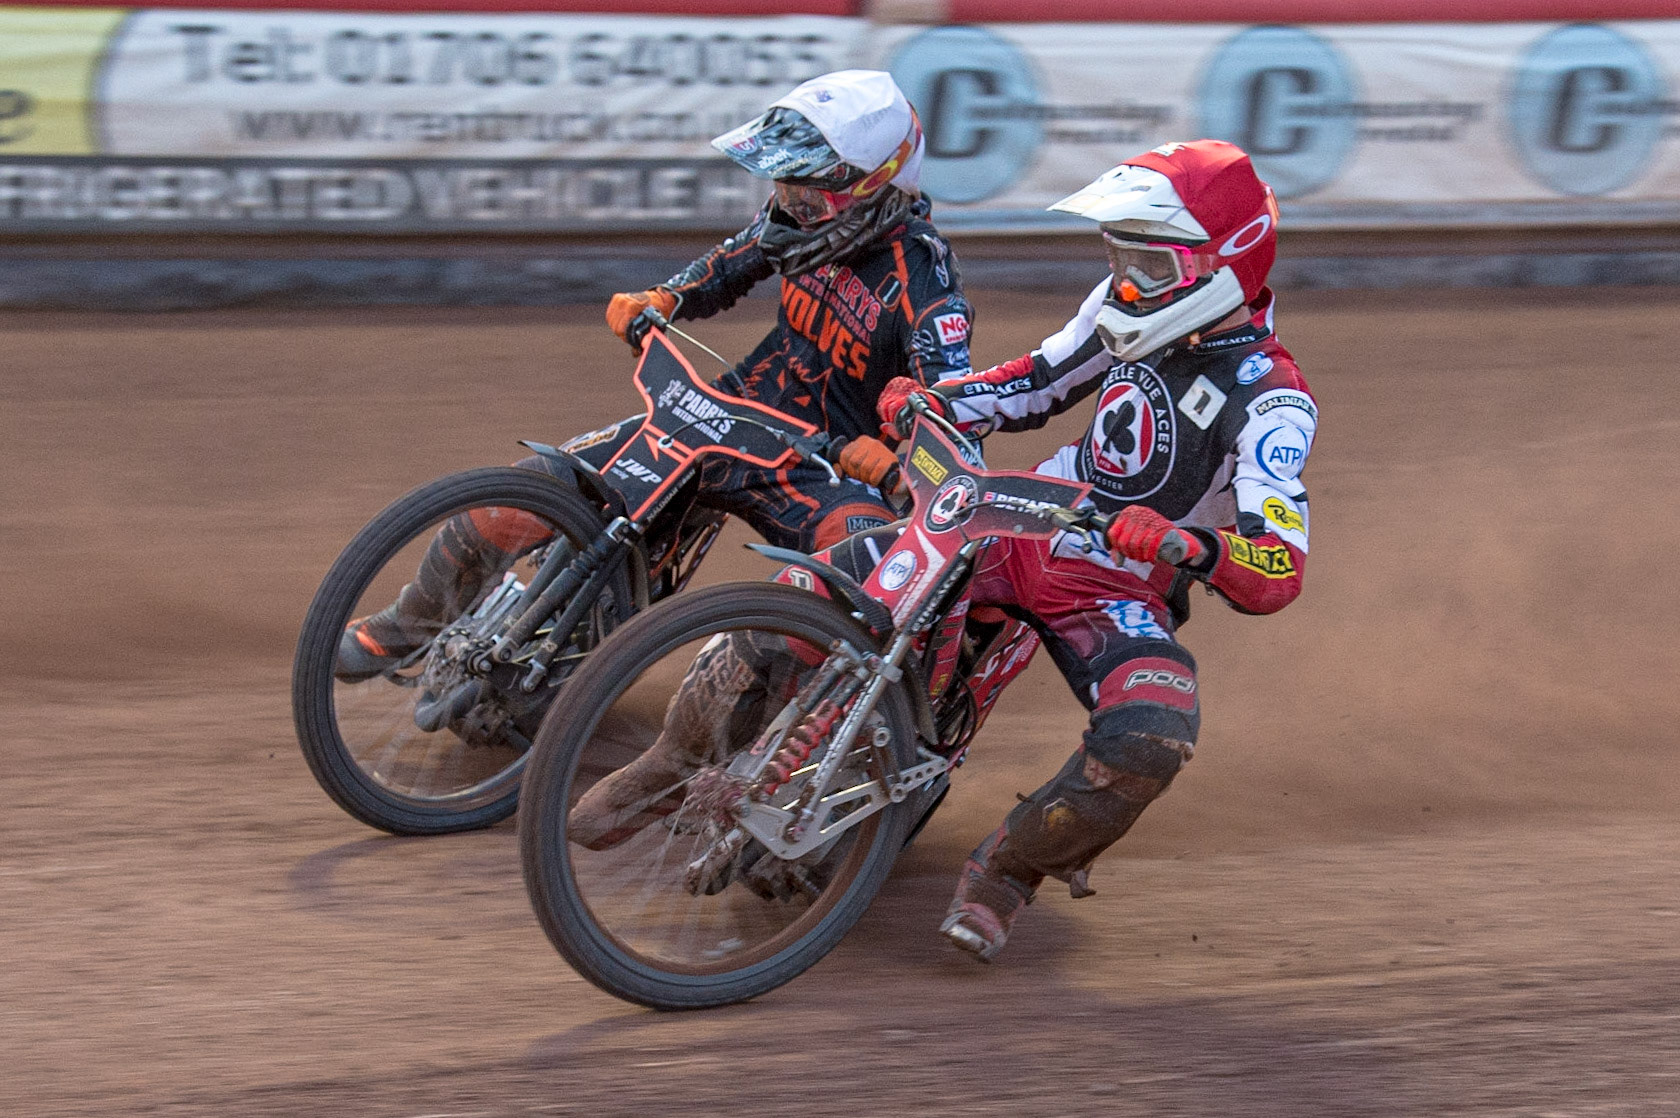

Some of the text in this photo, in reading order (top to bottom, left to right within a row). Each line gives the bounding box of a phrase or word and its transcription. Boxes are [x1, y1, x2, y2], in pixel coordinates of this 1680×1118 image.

[799, 274, 871, 346] INTENATIONAL
[678, 388, 736, 434] PARRYS
[1138, 369, 1162, 402] VUE
[1154, 407, 1171, 454] ACES
[615, 458, 662, 483] JWP
